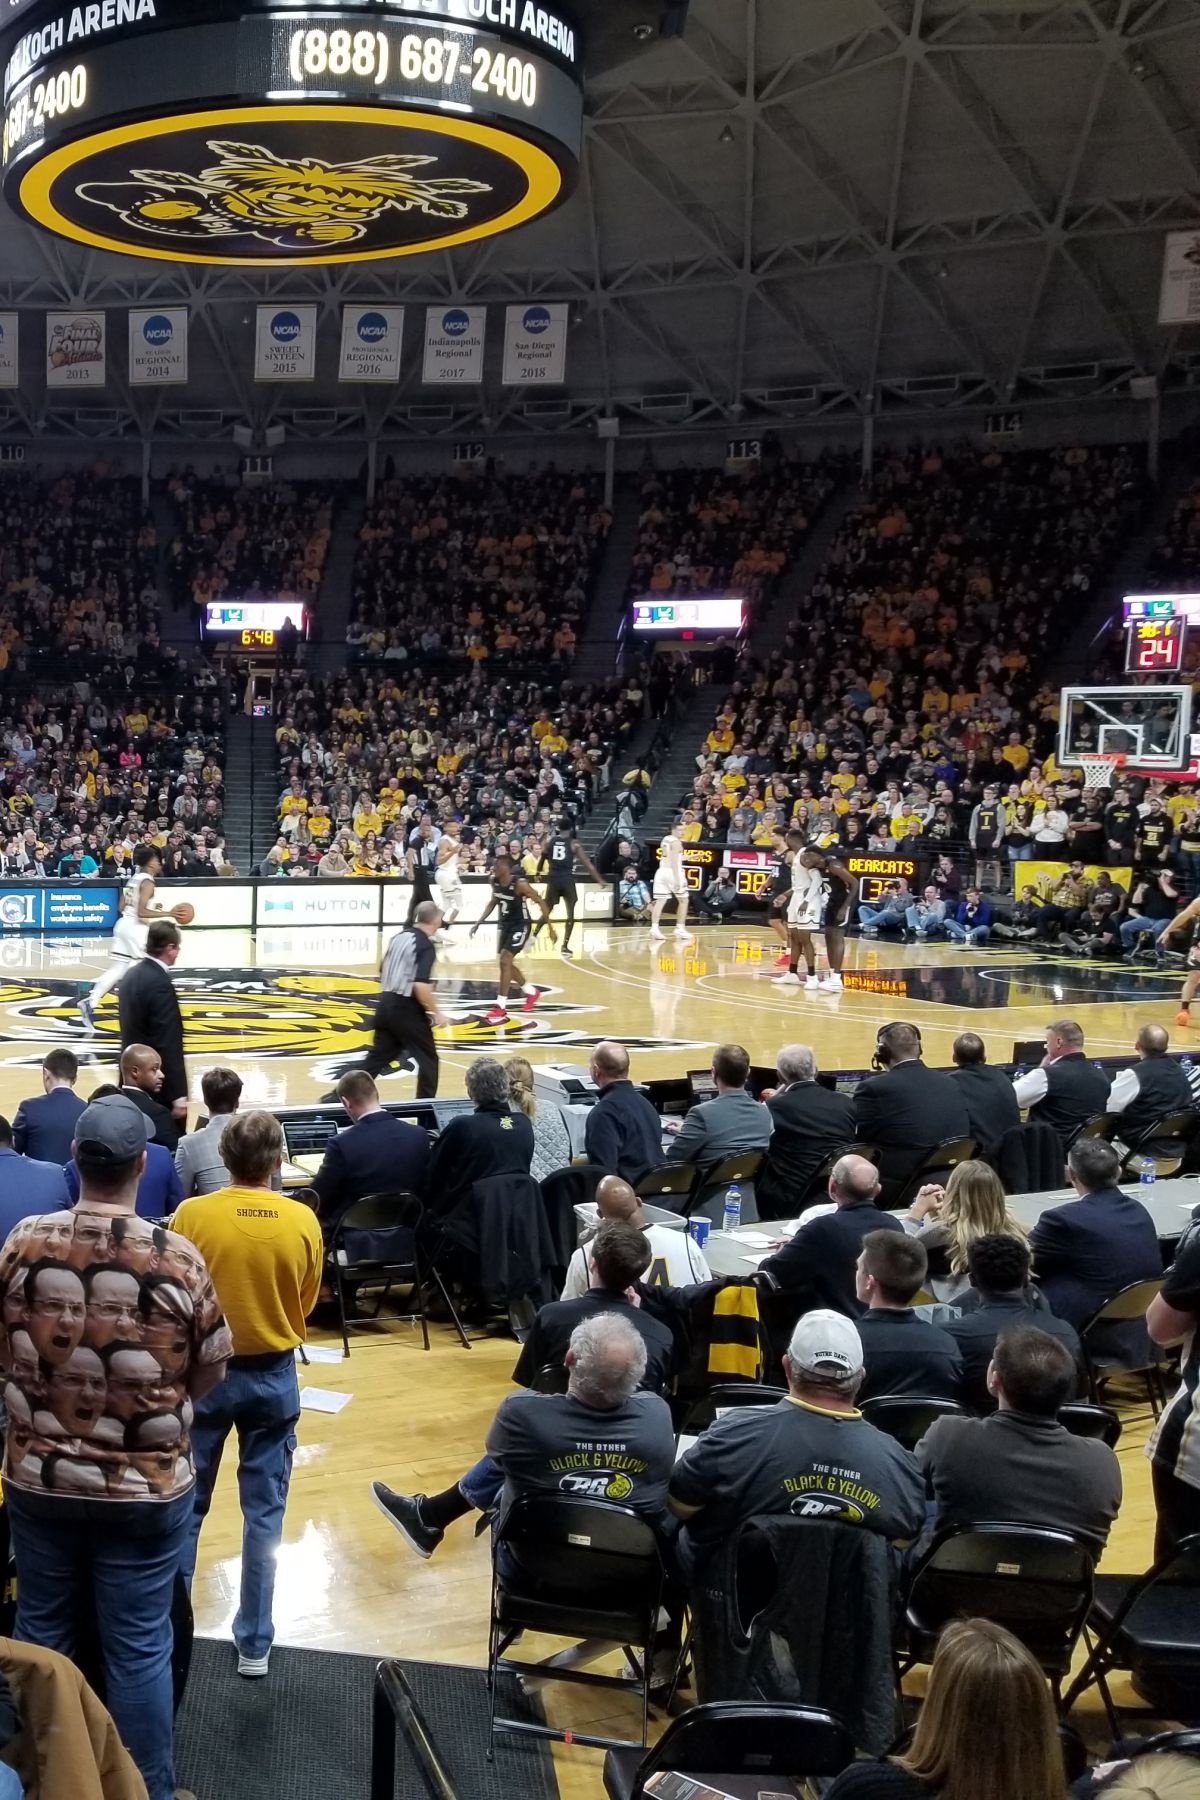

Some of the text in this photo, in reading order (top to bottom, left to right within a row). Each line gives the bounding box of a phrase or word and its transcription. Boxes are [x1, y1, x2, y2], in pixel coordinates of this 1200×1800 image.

[22, 18, 63, 64] KOCH
[67, 0, 156, 41] ARENA
[520, 1, 575, 63] ARENA
[289, 28, 537, 107] (888) 687-2400
[444, 321, 469, 331] NCAA
[524, 319, 551, 329] NCAA
[64, 325, 100, 340] FINAL
[146, 329, 173, 339] NCAA
[273, 326, 300, 336] NCAA
[359, 327, 388, 336] NCAA
[49, 335, 99, 354] FOUR
[428, 337, 481, 348] Indianapolis
[515, 341, 556, 351] San Diego
[264, 352, 305, 361] SIXTEEN
[346, 354, 395, 362] REGIONAL
[435, 349, 473, 359] Regional
[517, 350, 552, 360] Regional
[135, 356, 181, 365] REGIONAL
[146, 367, 170, 377] 2014
[272, 363, 297, 373] 2015
[356, 363, 381, 374] 2016
[439, 368, 466, 378] 2017
[520, 367, 546, 378] 2018
[66, 369, 90, 379] 2013
[984, 414, 1022, 433] 114
[454, 443, 484, 460] 112
[728, 440, 761, 458] 113
[245, 456, 273, 473] 111
[241, 629, 274, 645] 6:48
[1139, 639, 1173, 666] 24
[656, 848, 713, 863] SKERS
[849, 858, 915, 875] BEARCATS
[50, 893, 82, 901] insurance
[50, 902, 110, 913] employee benefits
[305, 899, 371, 912] HUTTON
[50, 913, 104, 924] workplace safety
[236, 1206, 279, 1219] SHOCKERS
[814, 1350, 848, 1363] NOTRE DAME
[575, 1442, 626, 1452] THE OTHER
[548, 1452, 648, 1473] BLACK & YELLOW
[812, 1463, 861, 1480] THE OTHER
[783, 1475, 881, 1510] BLACK & YELLOW
